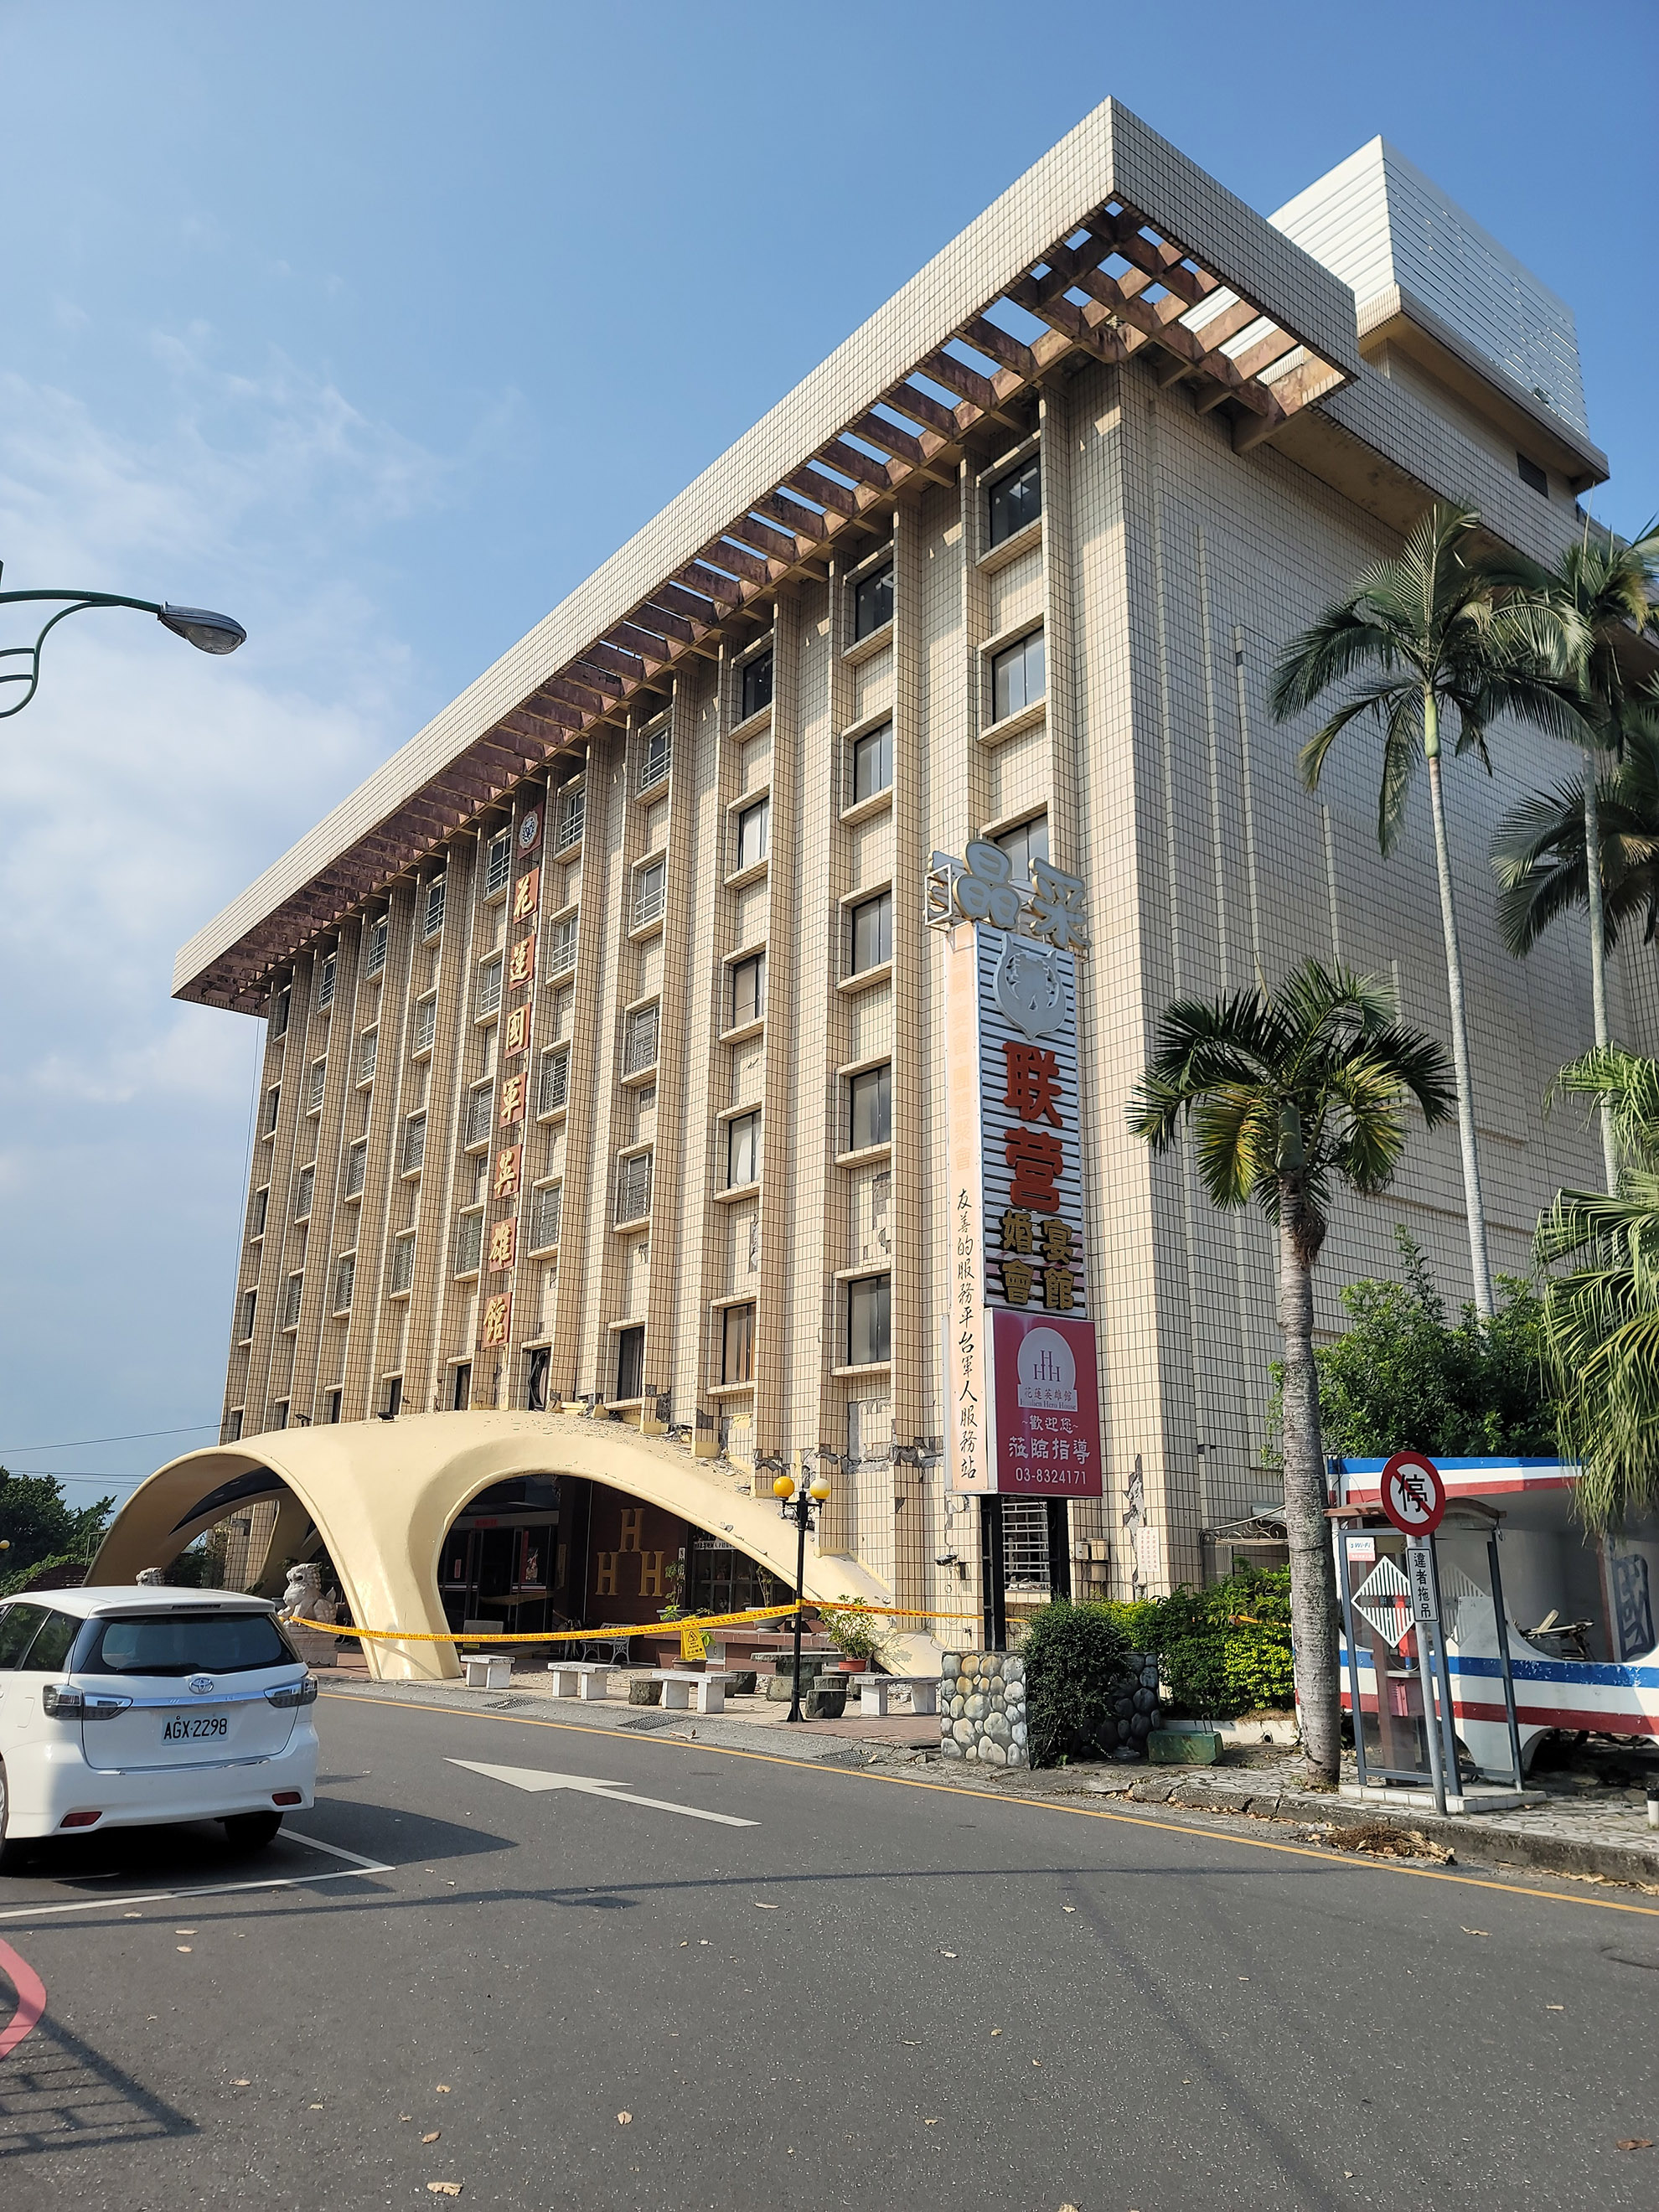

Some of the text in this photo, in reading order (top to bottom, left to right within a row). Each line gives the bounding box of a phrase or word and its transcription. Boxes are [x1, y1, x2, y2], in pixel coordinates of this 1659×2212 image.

[483, 875, 535, 1343] 花蓮國軍英雄館
[957, 1188, 978, 1480] 友善的服務平台軍人服務站
[1025, 1387, 1072, 1402] 花蓮英雄館
[1008, 1435, 1090, 1465] 蒞臨指導
[1016, 1467, 1086, 1485] 03-8324171
[1398, 1474, 1429, 1514] 停
[1414, 1553, 1431, 1618] 違者拖吊
